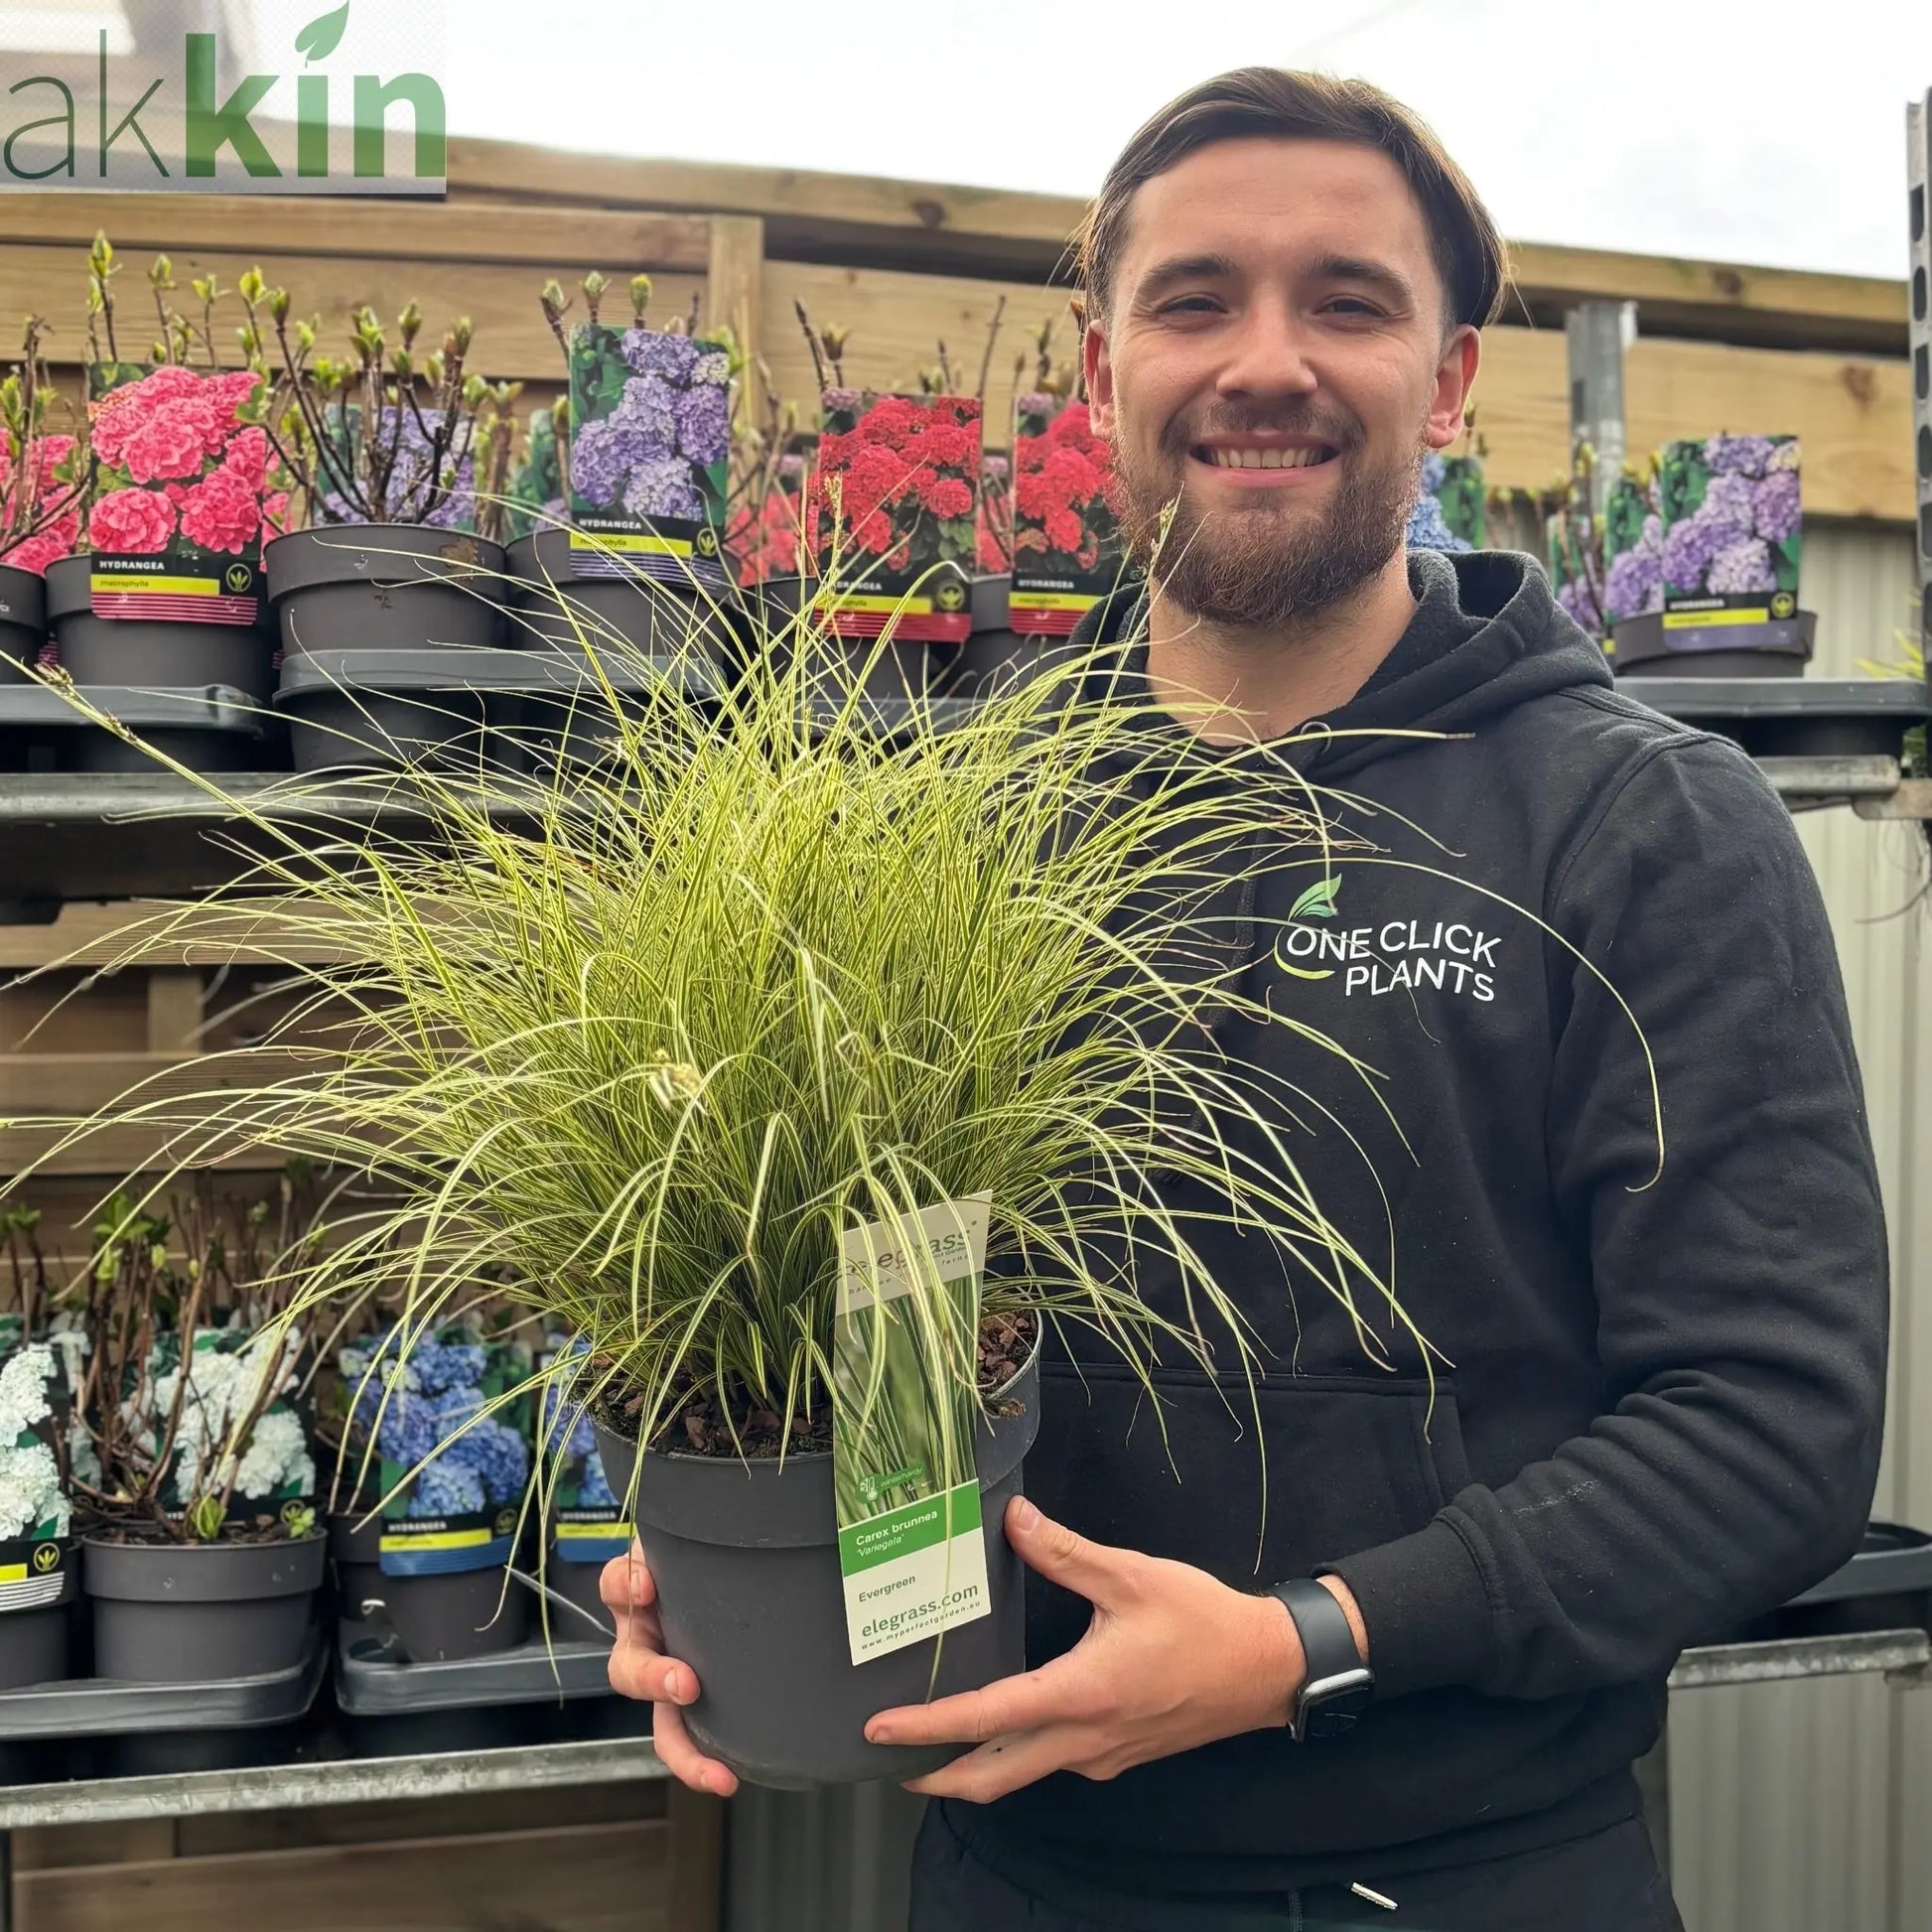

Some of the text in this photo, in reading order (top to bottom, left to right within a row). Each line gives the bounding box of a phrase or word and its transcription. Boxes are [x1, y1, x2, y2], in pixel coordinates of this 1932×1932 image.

[579, 518, 641, 530] HYDRANGEA
[99, 560, 165, 571] HYDRANGEA
[1287, 920, 1502, 968] ONE CLICK
[1345, 958, 1495, 1002] PLANTS
[856, 1510, 938, 1546] Carex brunnea
[859, 1576, 915, 1602] Evergreen
[862, 1585, 978, 1637] elegrass.com
